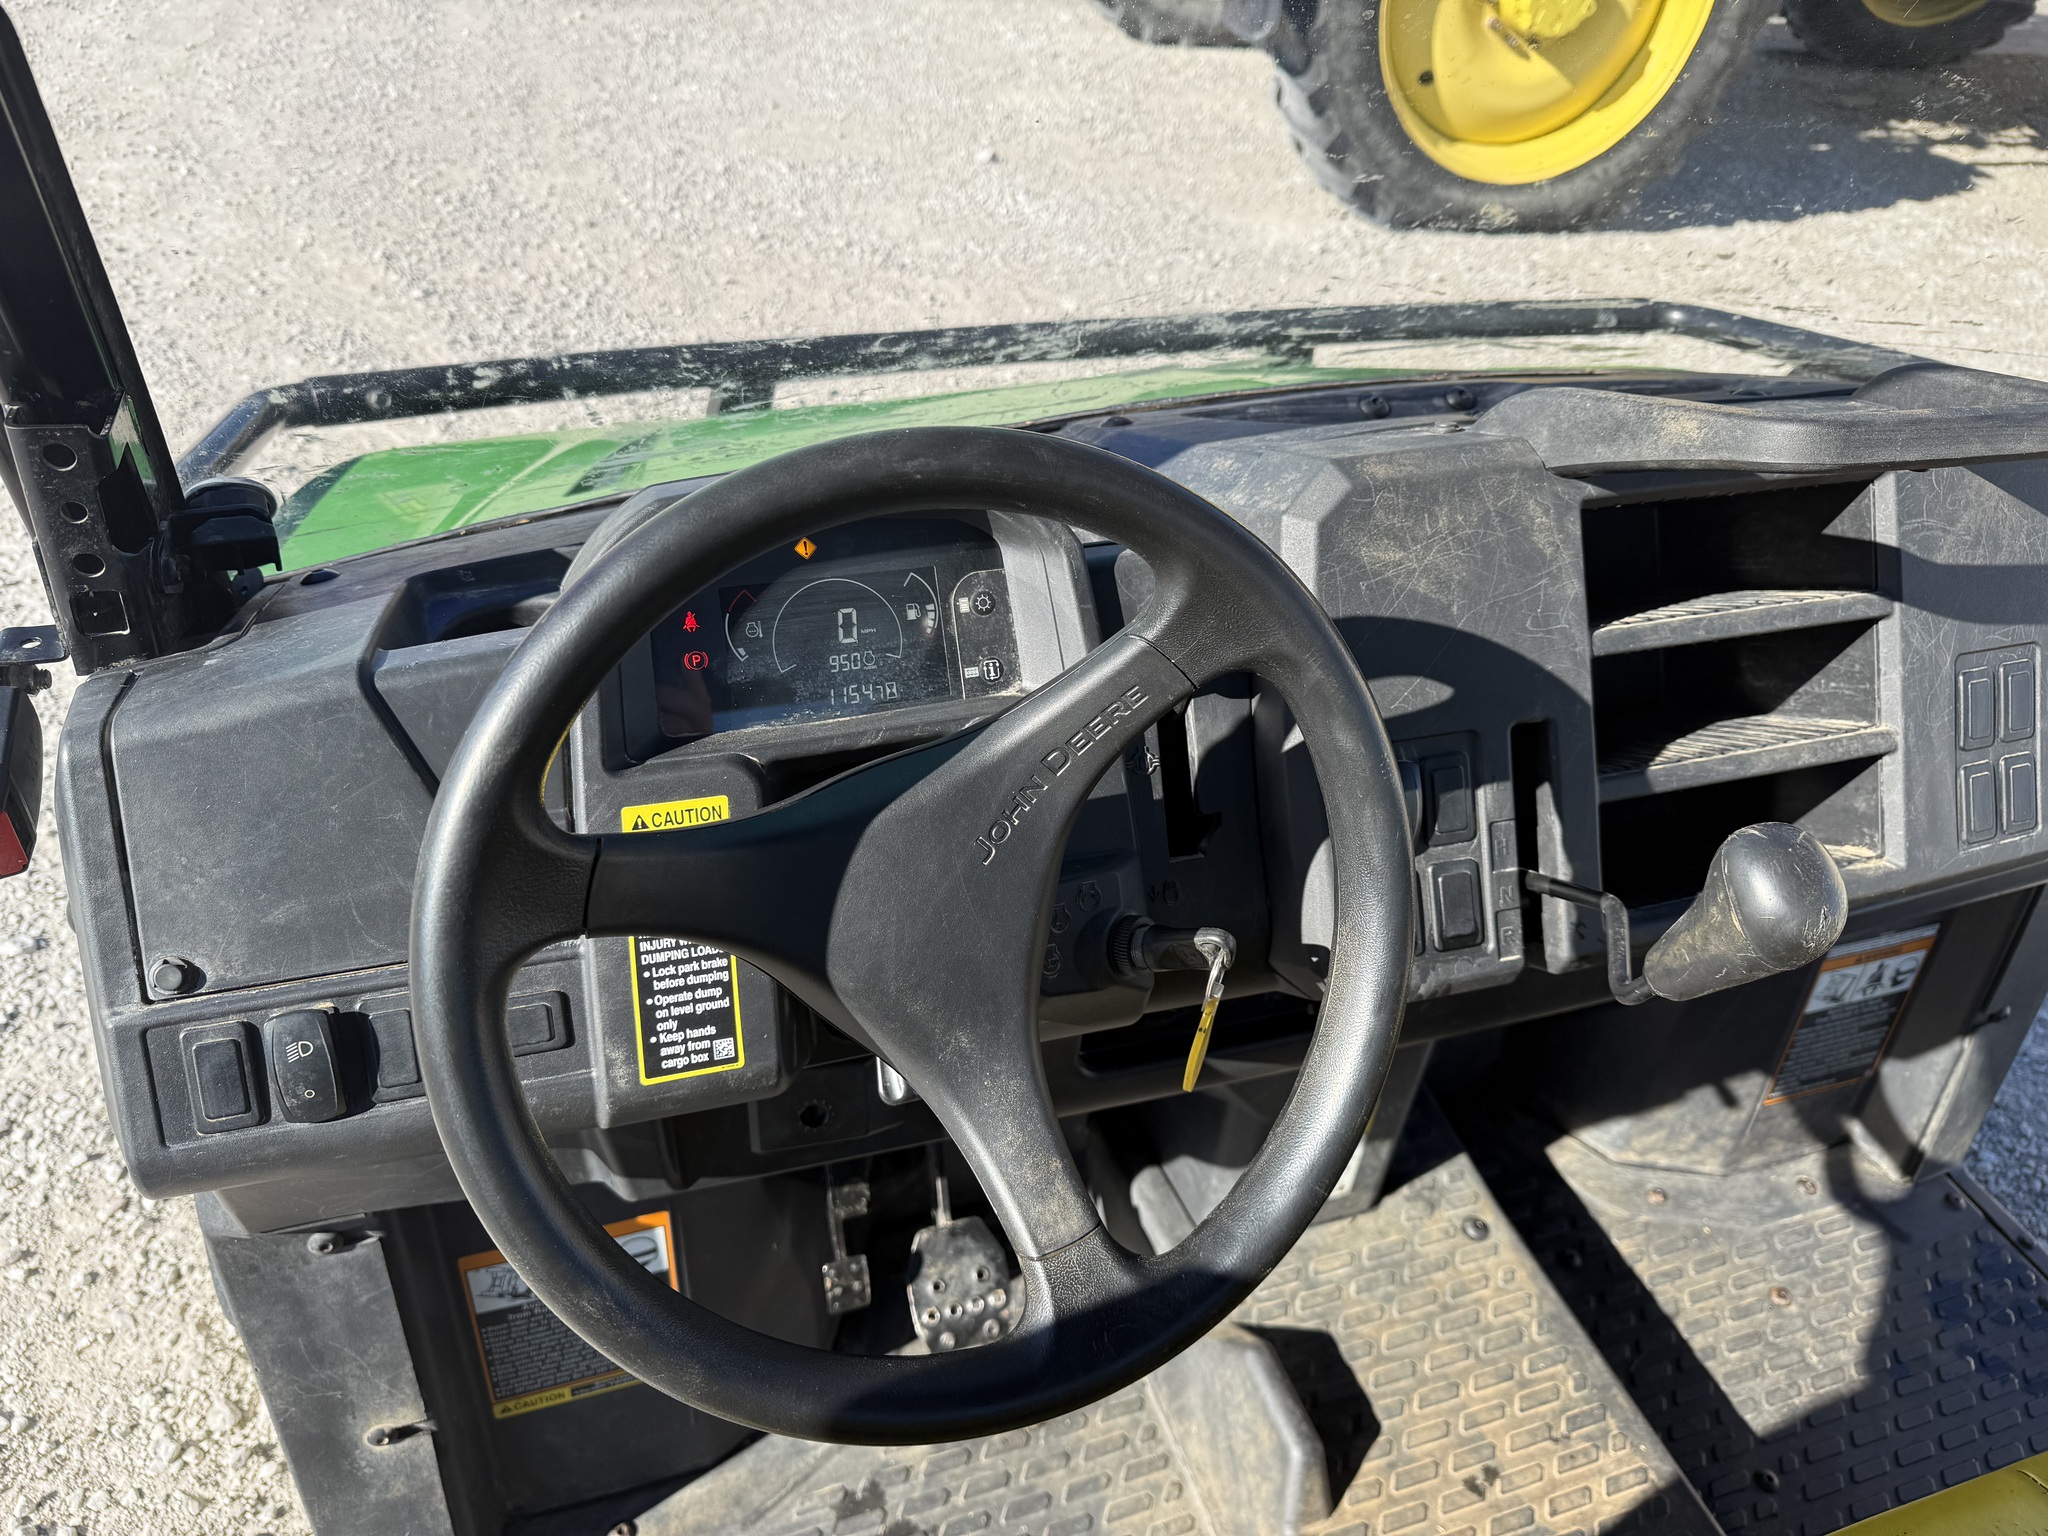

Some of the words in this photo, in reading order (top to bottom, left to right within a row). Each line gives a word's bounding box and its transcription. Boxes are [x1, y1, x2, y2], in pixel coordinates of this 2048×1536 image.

[838, 608, 858, 643] 0
[830, 653, 860, 672] 950
[976, 775, 1048, 866] JOHN
[1041, 685, 1149, 776] DEERE
[651, 805, 722, 828] CAUTION
[1500, 885, 1514, 906] N
[639, 938, 677, 952] INJURY
[1501, 926, 1515, 945] R
[640, 948, 689, 965] DUMPING
[691, 945, 724, 958] LOA
[652, 964, 676, 977] Lock
[678, 961, 700, 976] park
[701, 957, 728, 970] brake
[653, 977, 685, 990] before
[687, 970, 729, 985] dumping
[654, 991, 693, 1007] Operate
[694, 986, 723, 998] dump
[655, 1009, 669, 1018] on
[671, 1003, 694, 1016] level
[695, 996, 730, 1014] ground
[656, 1019, 678, 1031] only
[659, 1031, 685, 1043] Keep
[686, 1024, 717, 1039] hands
[660, 1043, 685, 1056] away
[687, 1039, 711, 1051] from
[661, 1056, 690, 1069] cargo
[690, 1052, 710, 1064] box
[513, 1391, 566, 1410] CAUTION
